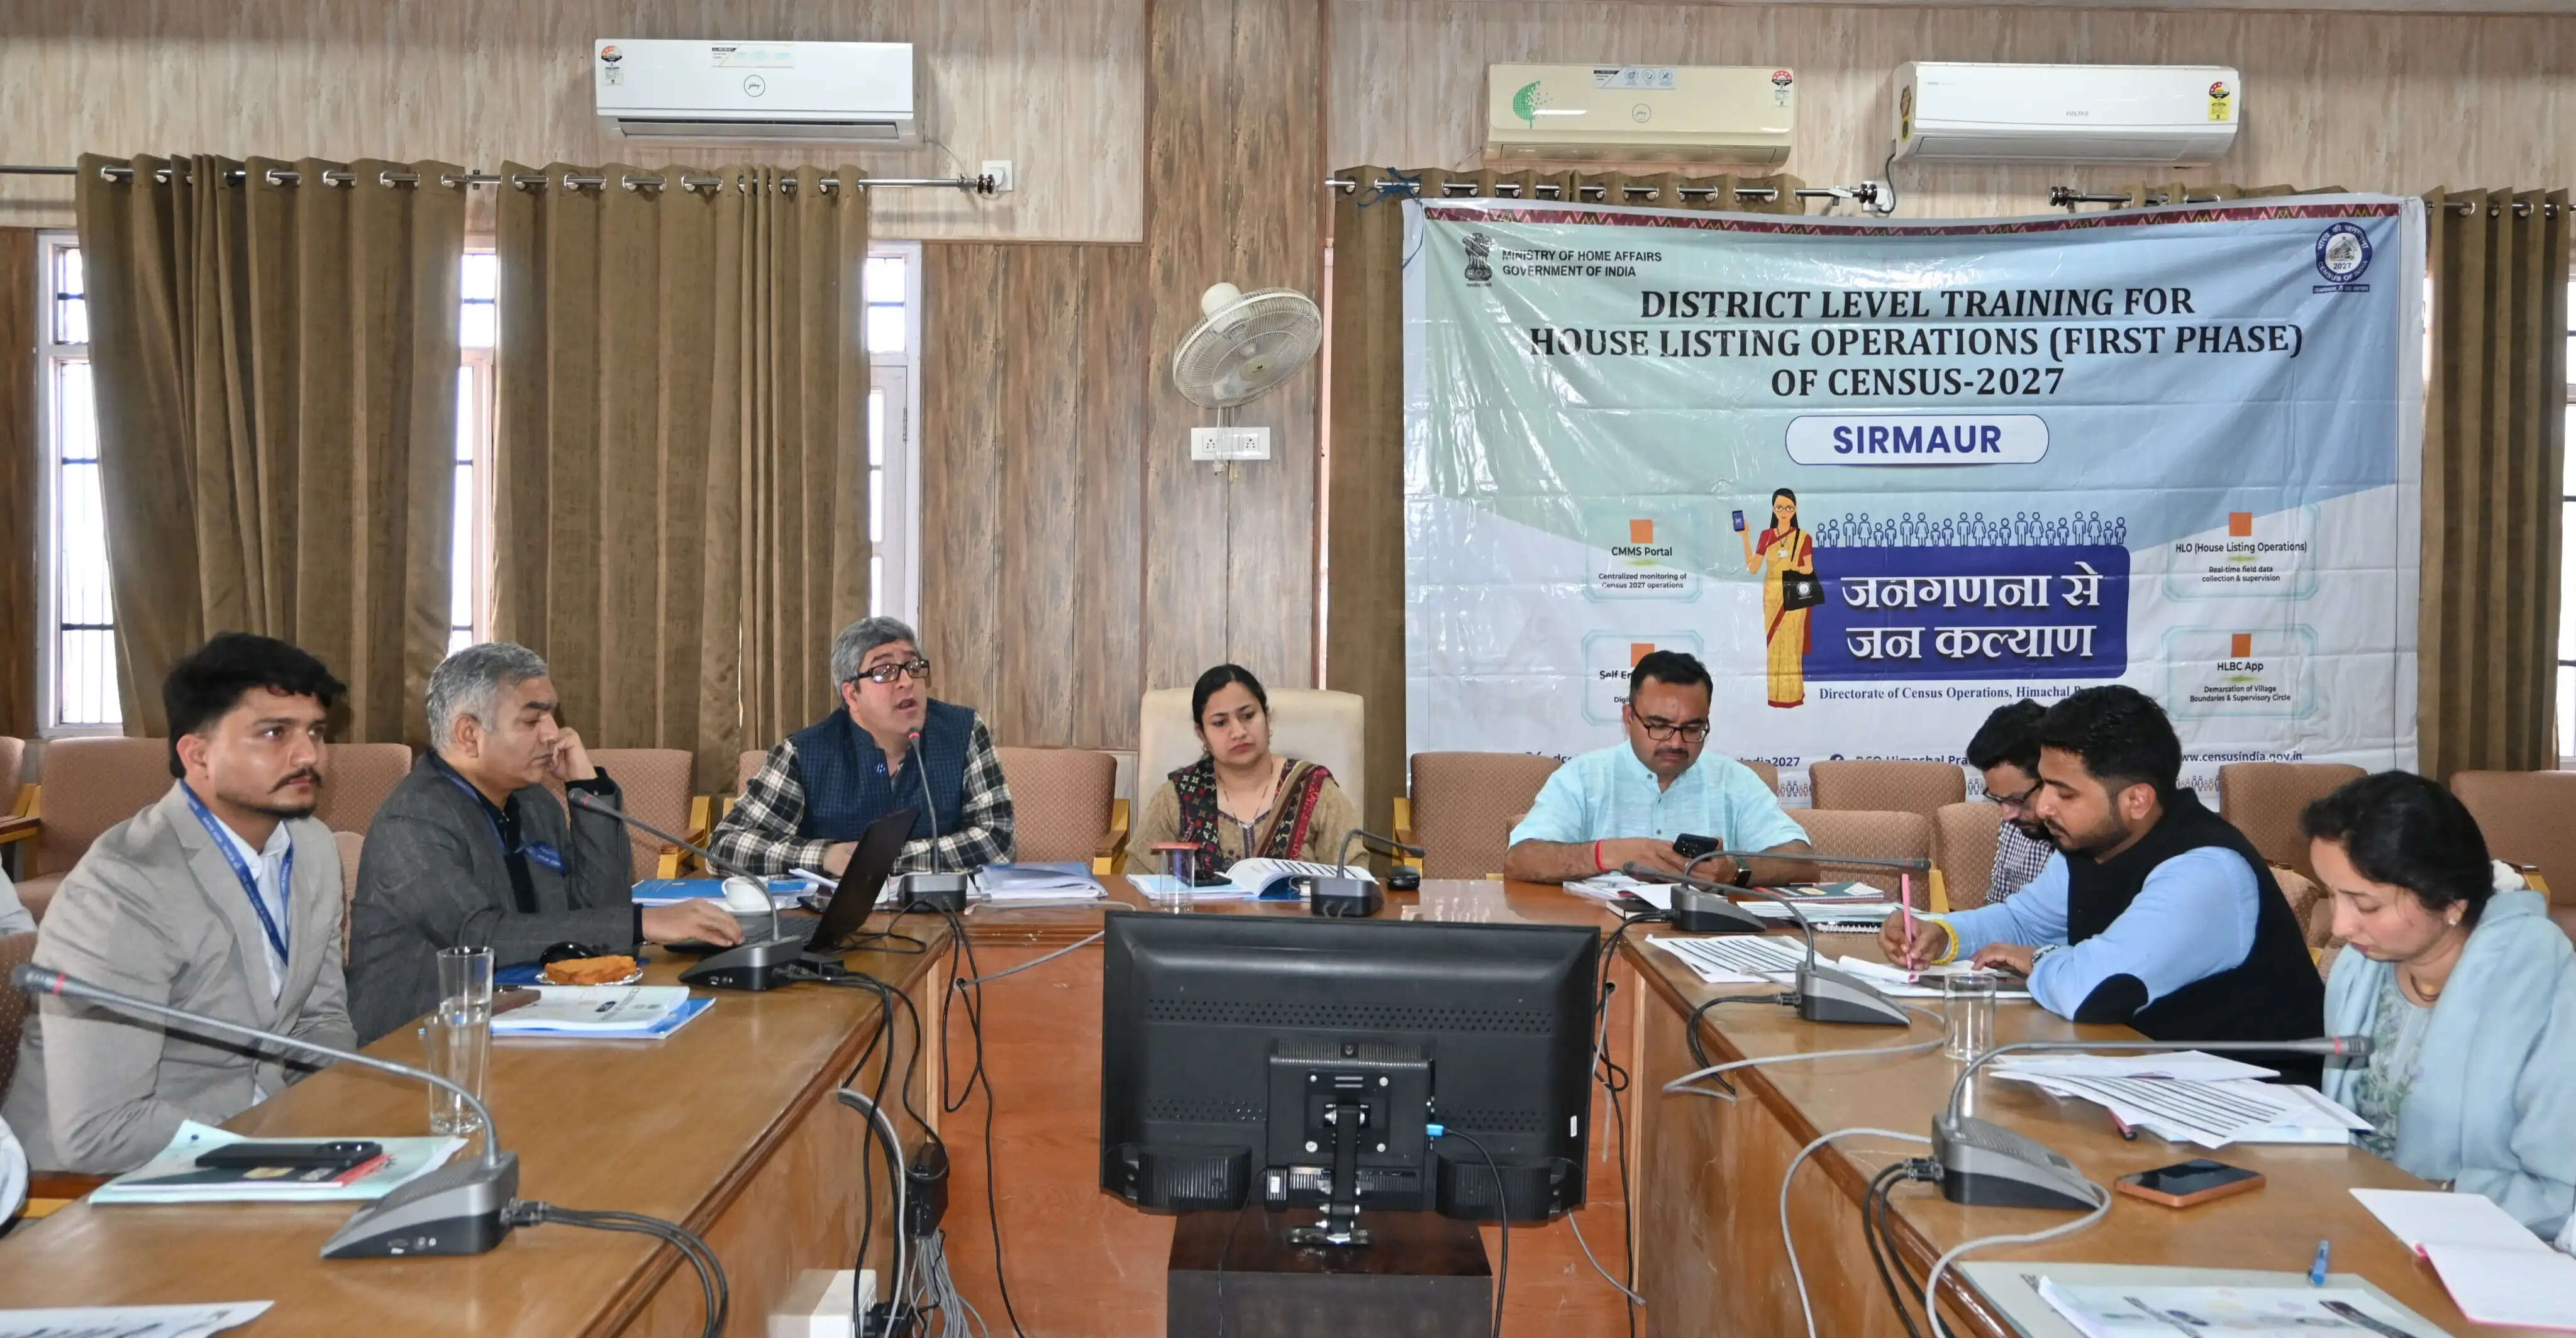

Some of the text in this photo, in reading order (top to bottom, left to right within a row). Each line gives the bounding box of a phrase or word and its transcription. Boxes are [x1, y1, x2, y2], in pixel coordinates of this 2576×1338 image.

[1502, 250, 1662, 262] MINISTRY OF HOME AFFAIRS
[1502, 265, 1636, 277] GOVERNMENT OF INDIA
[2318, 262, 2341, 282] CENSUS
[2354, 260, 2368, 277] INDIA
[1641, 287, 2195, 319] DISTRICT LEVEL TRAINING FOR
[1529, 324, 2303, 362] HOUSE LISTING OPERATIONS (FIRST PHASE)
[1772, 367, 2065, 397] OF CENSUS-2027
[1833, 424, 2002, 455] SIRMAUR
[1611, 546, 1672, 556] CMMS Portal
[2175, 541, 2307, 554] HLO (House Listing Operations)
[1840, 561, 2103, 608] जनगणना से
[2242, 575, 2280, 583] supervision
[1846, 625, 2097, 659] जन कल्याण
[2217, 661, 2264, 672] HLBC App
[1599, 670, 1619, 680] Self
[1819, 688, 1885, 699] Directorate
[1887, 687, 1900, 699] of
[1902, 687, 1943, 699] Census
[1946, 687, 2012, 701] Operations,
[2016, 686, 2070, 697] Himachal
[2204, 685, 2245, 693] Demarcation
[2254, 685, 2277, 693] Village
[2233, 694, 2271, 703] Supervisory
[1948, 756, 1968, 765] Pra
[2182, 751, 2302, 763] ww.censusindia.gov.in
